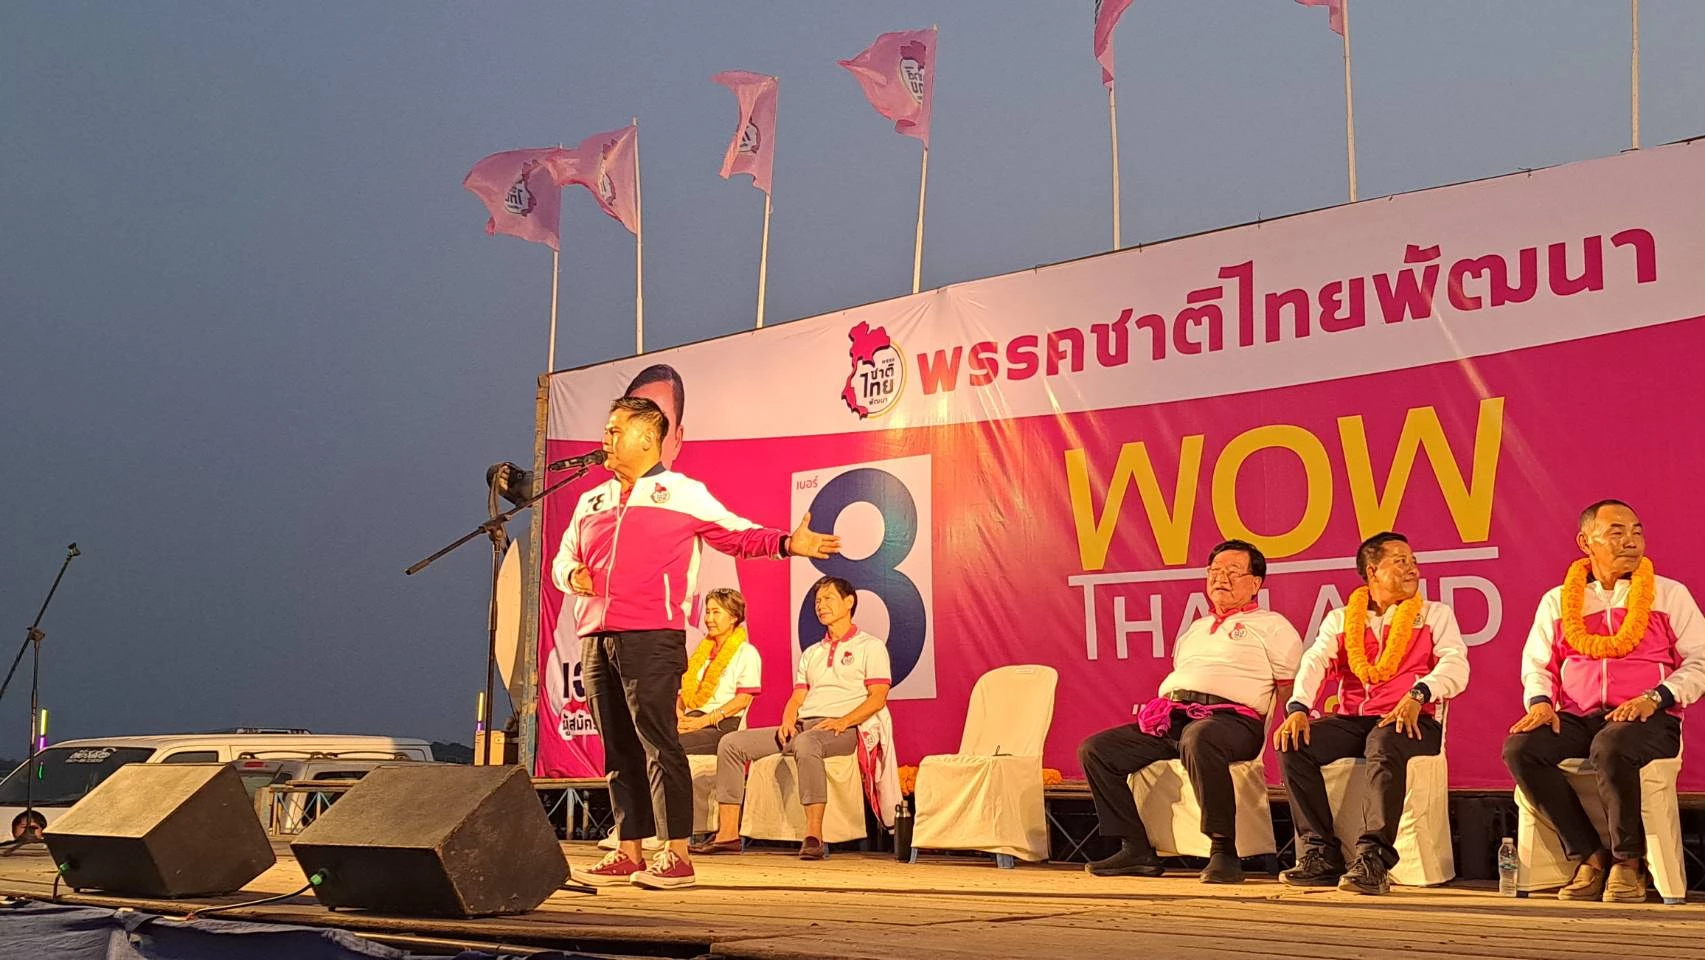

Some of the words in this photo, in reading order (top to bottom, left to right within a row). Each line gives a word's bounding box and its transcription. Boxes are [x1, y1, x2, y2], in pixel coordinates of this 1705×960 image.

[917, 228, 1657, 395] พรรคชาติไทยพัฒนา
[870, 363, 895, 380] ชาติ
[860, 372, 894, 398] ไทย
[796, 475, 818, 490] เบอร์
[1064, 396, 1505, 571] WOW
[798, 468, 926, 690] 8
[562, 713, 598, 736] ผู้สมัค
